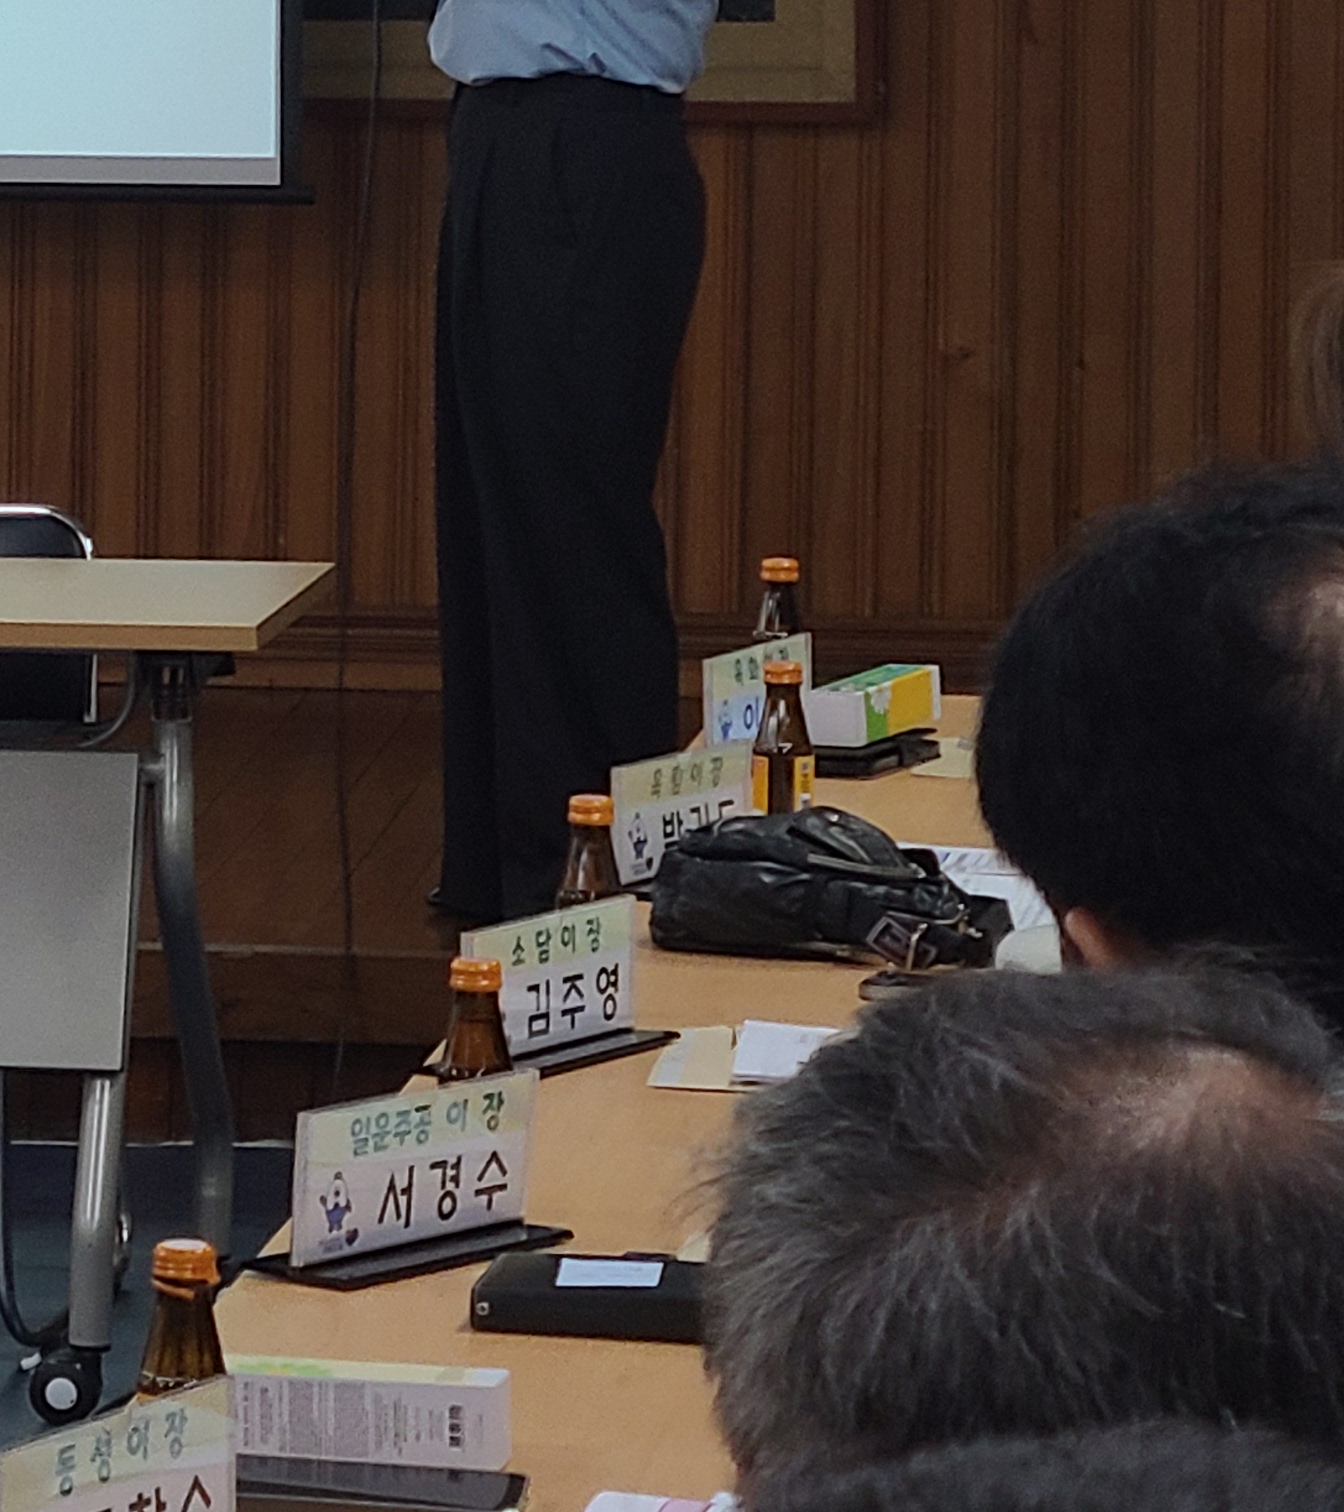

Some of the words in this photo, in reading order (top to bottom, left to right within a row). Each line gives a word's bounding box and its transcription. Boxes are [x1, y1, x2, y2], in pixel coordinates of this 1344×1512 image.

[511, 916, 601, 966] 소담이장
[526, 963, 620, 1039] 김주영
[377, 1150, 509, 1230] 서경수
